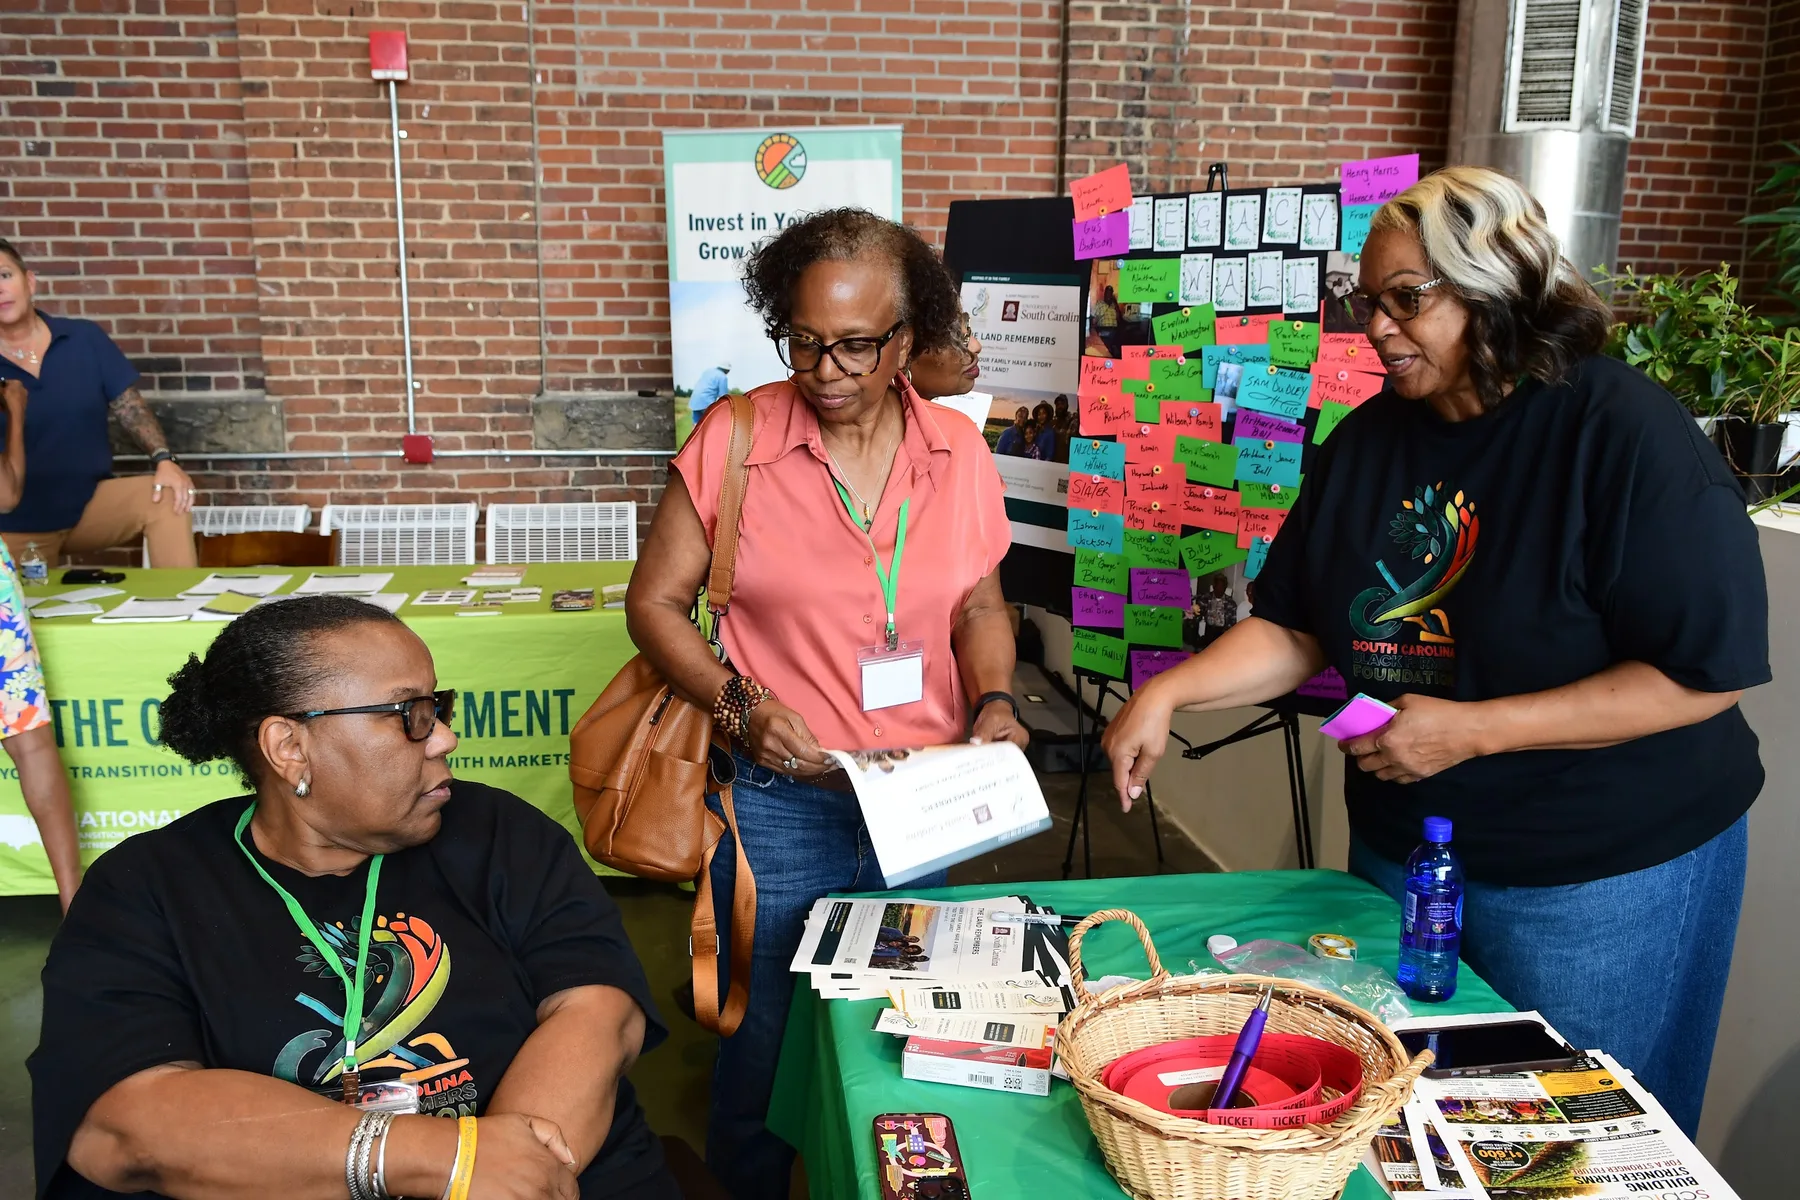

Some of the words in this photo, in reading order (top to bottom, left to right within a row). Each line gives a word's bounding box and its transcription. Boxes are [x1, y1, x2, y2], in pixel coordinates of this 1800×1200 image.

[688, 213, 744, 231] Invest
[751, 213, 767, 231] in
[1132, 198, 1328, 239] LEGACY
[699, 242, 743, 261] Grow
[1188, 264, 1311, 298] WALL
[1021, 310, 1046, 321] South
[1047, 311, 1080, 323] Carolin
[980, 332, 1002, 342] LAND
[1004, 335, 1057, 346] REMEMBERS
[1317, 374, 1362, 398] Frankie
[1126, 499, 1153, 515] Prince
[1183, 500, 1204, 512] Susan
[1213, 505, 1238, 518] Holmes
[1242, 509, 1270, 521] Prince
[1127, 513, 1146, 530] Mary
[1244, 522, 1267, 533] Lillie
[1073, 641, 1098, 655] ALLEN
[1352, 639, 1398, 654] SOUTH
[1401, 644, 1455, 658] CAROLINA
[1353, 651, 1403, 668] BLACK
[50, 698, 129, 748] THE
[489, 753, 570, 768] MARKETS
[69, 764, 183, 779] TRANSITION
[190, 763, 212, 778] TO
[75, 810, 181, 829] ATIONA
[975, 916, 983, 929] LAND
[971, 930, 982, 955] REMEMBERS
[1321, 1102, 1345, 1120] TICKET
[1217, 1115, 1254, 1127] TICKET
[1271, 1114, 1307, 1127] TICKET
[1478, 1149, 1523, 1159] $1,600
[1572, 1166, 1606, 1175] FUTURE
[1607, 1162, 1654, 1173] STRONGER
[1665, 1159, 1683, 1168] FOR
[1573, 1173, 1620, 1185] FARMS
[1619, 1166, 1690, 1180] STRONGER
[1625, 1176, 1699, 1192] BUILDING
